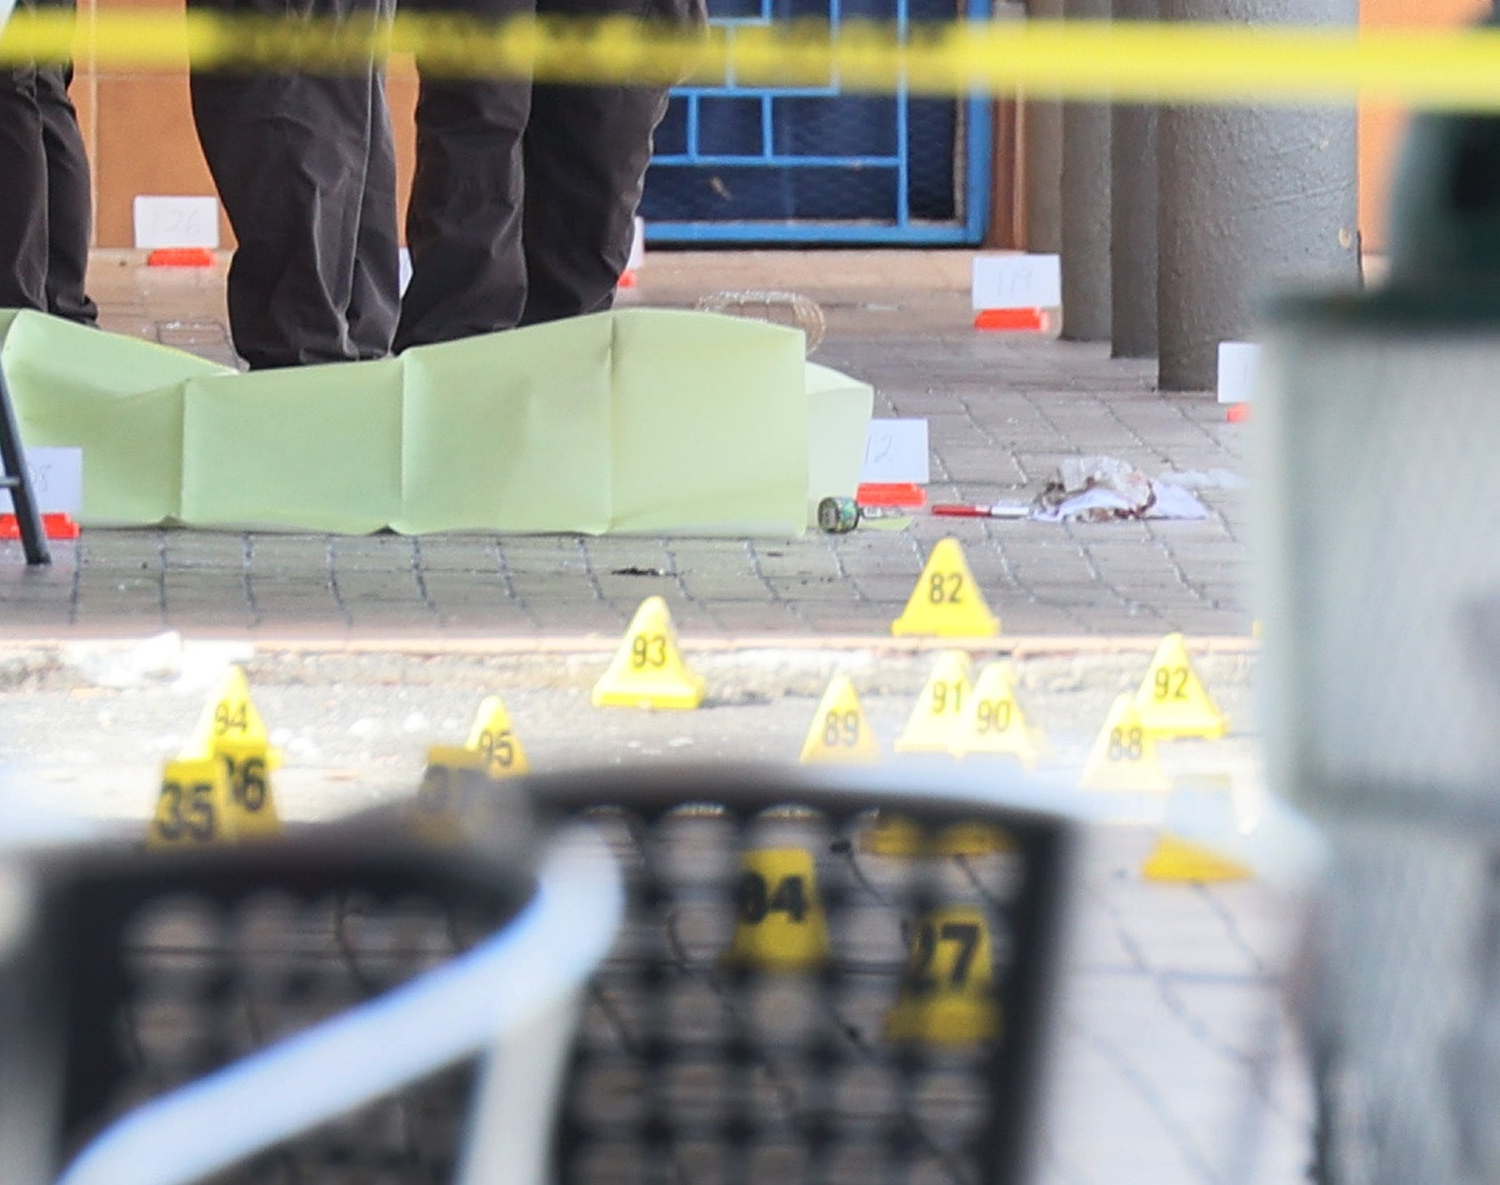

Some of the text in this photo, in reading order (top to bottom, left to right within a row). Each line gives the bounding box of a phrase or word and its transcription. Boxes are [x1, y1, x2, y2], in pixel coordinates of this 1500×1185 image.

[930, 572, 963, 604] 82
[633, 634, 666, 669] 93
[932, 679, 965, 714] 91
[1154, 666, 1188, 699] 92
[214, 700, 247, 734] 94
[823, 709, 859, 747] 89
[977, 700, 1011, 735] 90
[479, 730, 513, 767] 95
[1109, 726, 1143, 761] 88
